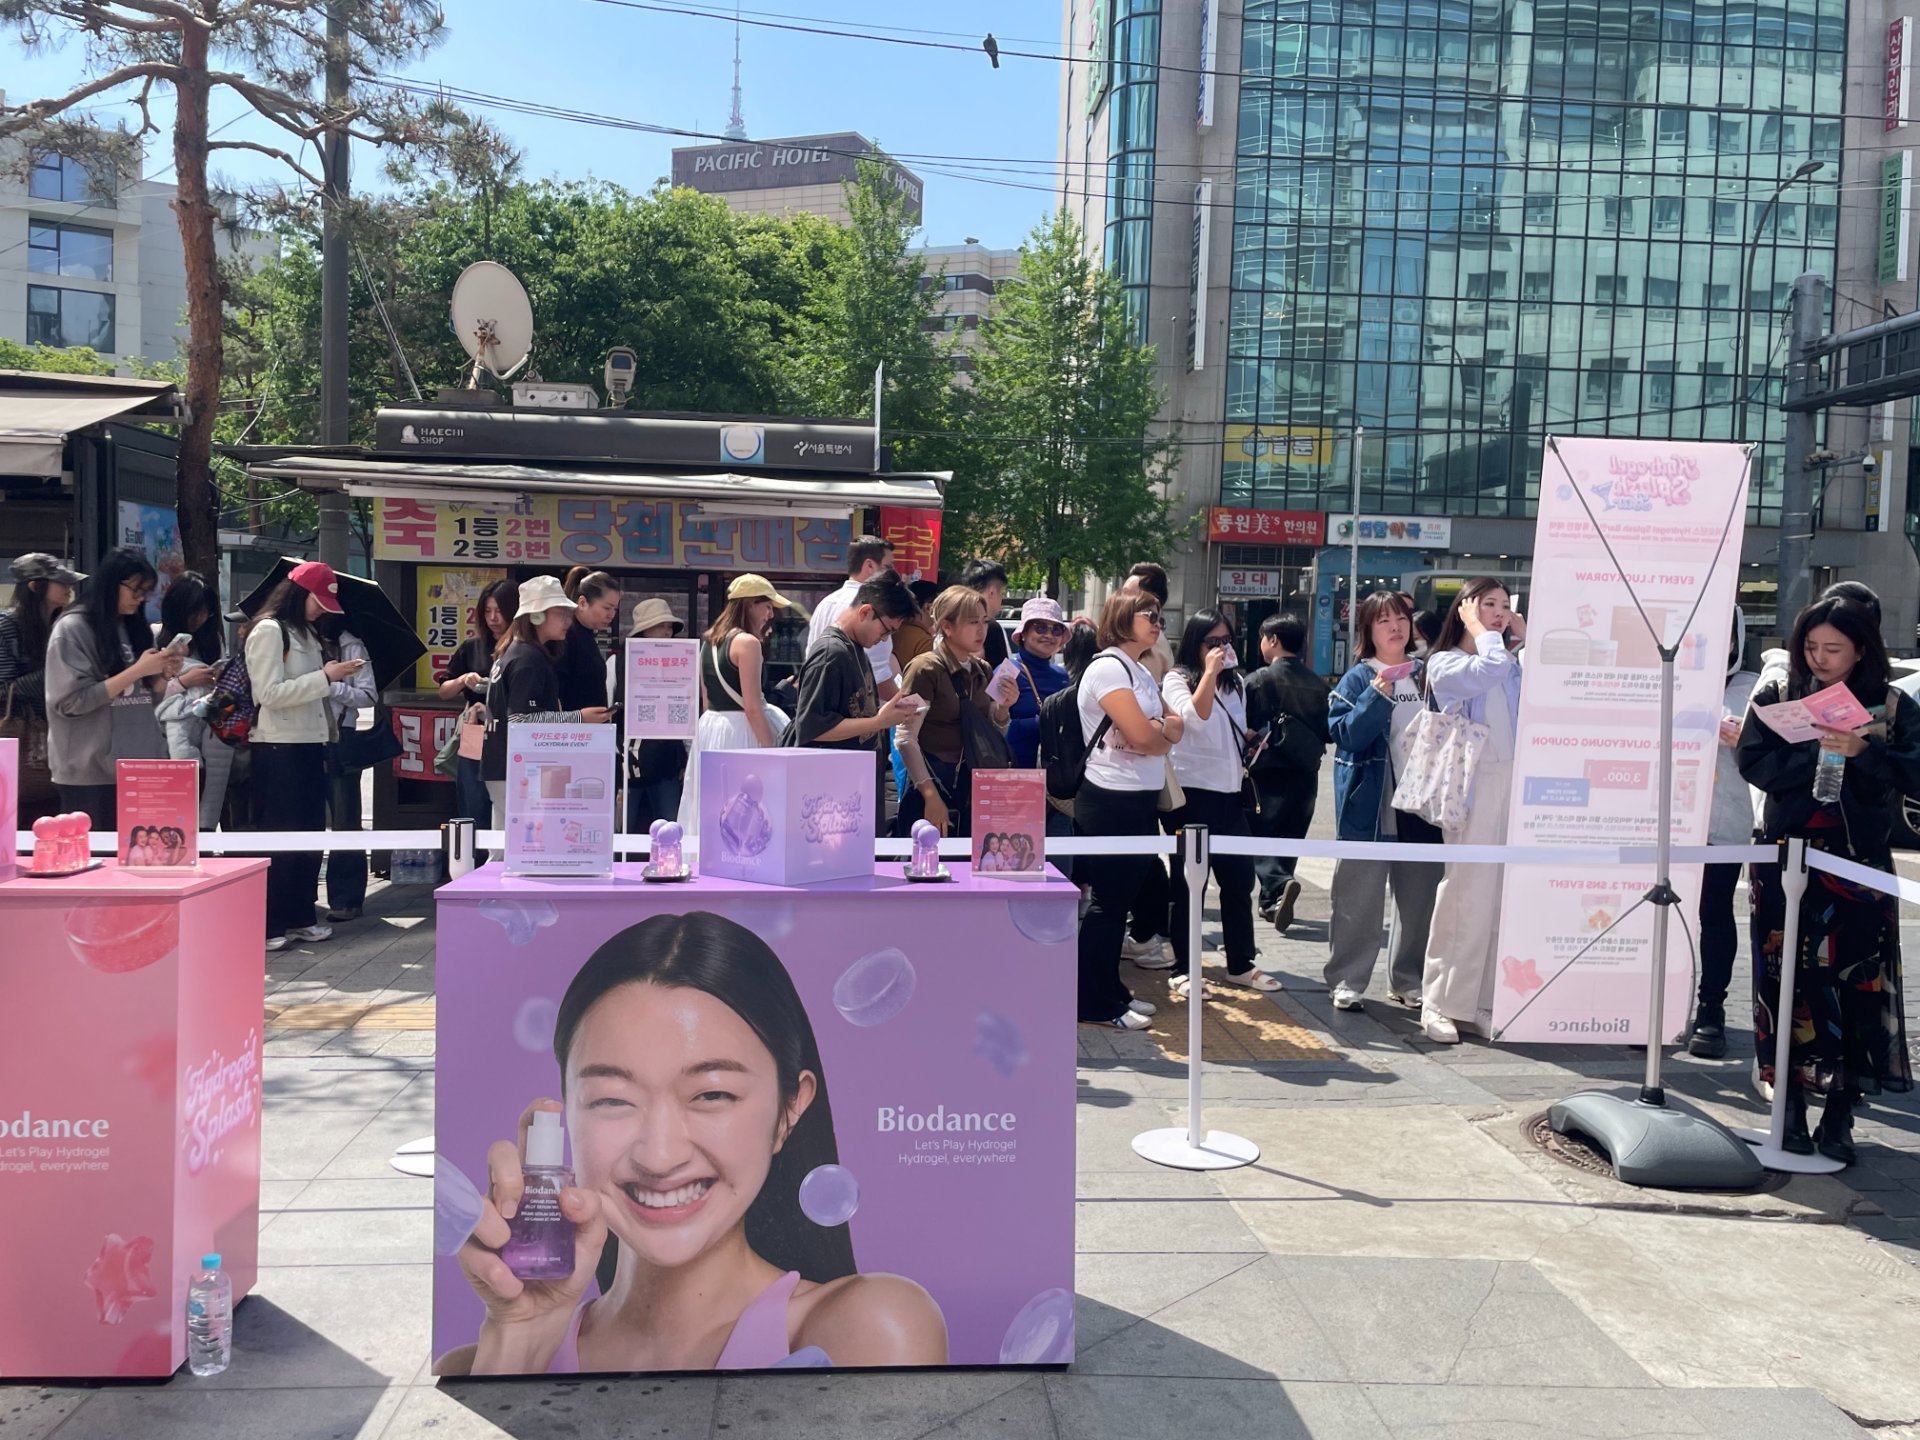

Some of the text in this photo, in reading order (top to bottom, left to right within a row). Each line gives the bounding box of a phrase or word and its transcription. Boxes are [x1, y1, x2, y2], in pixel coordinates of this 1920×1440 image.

[1886, 32, 1902, 116] 산부인과
[694, 151, 763, 173] PACIFIC
[771, 145, 831, 167] HOTEL
[420, 428, 464, 437] HAECHI
[420, 437, 444, 445] SHOP
[808, 443, 852, 455] 서울특별시
[383, 498, 437, 556] 축
[454, 517, 551, 538] 1등 2번
[1283, 519, 1317, 535] 한의원
[453, 539, 551, 560] 2등 3번
[429, 606, 458, 625] 1등
[427, 628, 458, 648] 2등
[638, 657, 659, 667] SNS
[570, 732, 593, 741] 이벤트
[801, 791, 862, 819] Hydrogel
[721, 851, 762, 866] Biodance
[184, 1036, 256, 1122] Hydrogel
[188, 1078, 254, 1172] Splash
[877, 1104, 1016, 1132] Biodance
[29, 1146, 53, 1159] Play
[56, 1146, 110, 1159] Hydrogel
[915, 1139, 1016, 1152] Let's Play Hydrogel
[39, 1160, 110, 1173] everywhere
[898, 1153, 1016, 1166] Hydrogel, everywhere
